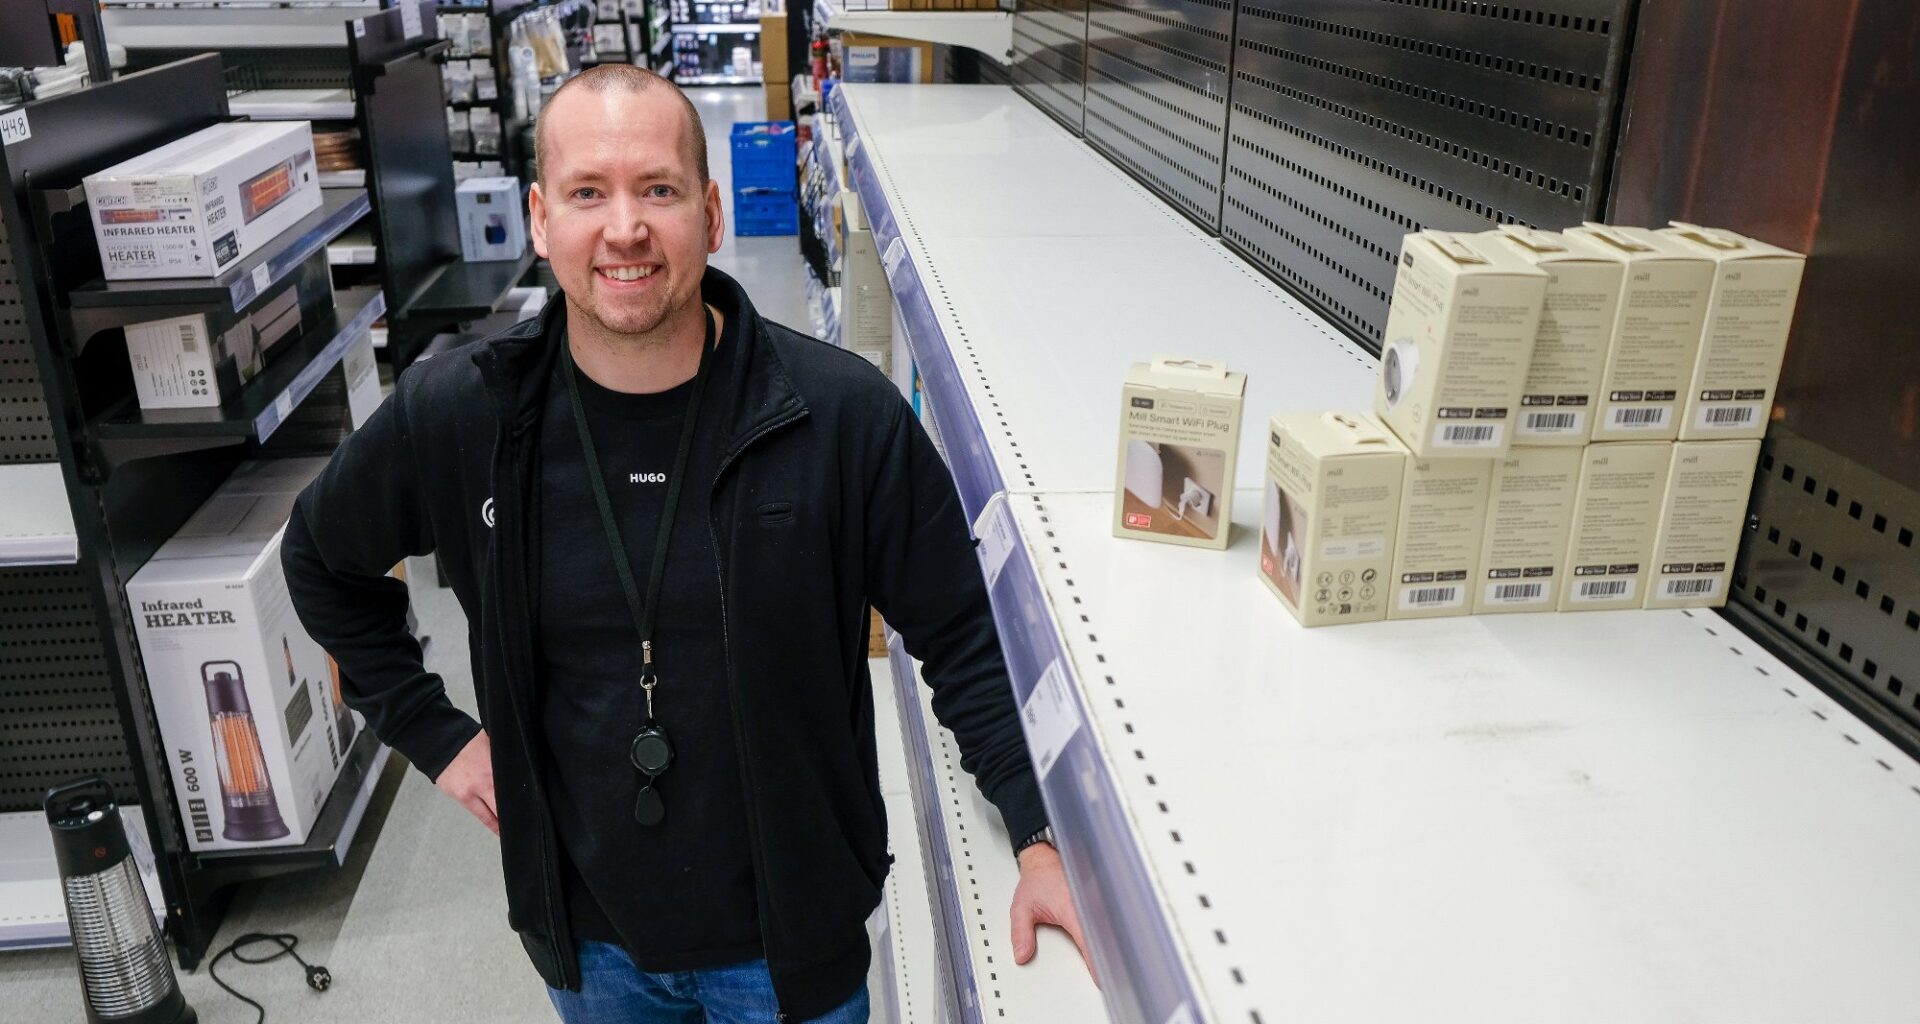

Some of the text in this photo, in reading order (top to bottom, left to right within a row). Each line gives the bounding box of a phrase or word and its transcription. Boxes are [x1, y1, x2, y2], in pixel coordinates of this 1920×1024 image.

[1, 117, 27, 138] 448
[206, 206, 227, 226] HEATER
[103, 225, 196, 237] INFRARED HEATER
[108, 250, 156, 262] HEATER
[1129, 410, 1148, 422] Mill
[1149, 413, 1180, 426] Smart
[1182, 416, 1206, 429] WiFi
[1206, 419, 1230, 433] Plug
[630, 472, 666, 483] HUGO
[141, 597, 204, 613] Infrared
[144, 610, 237, 629] HEATER
[178, 748, 200, 793] 600 W
